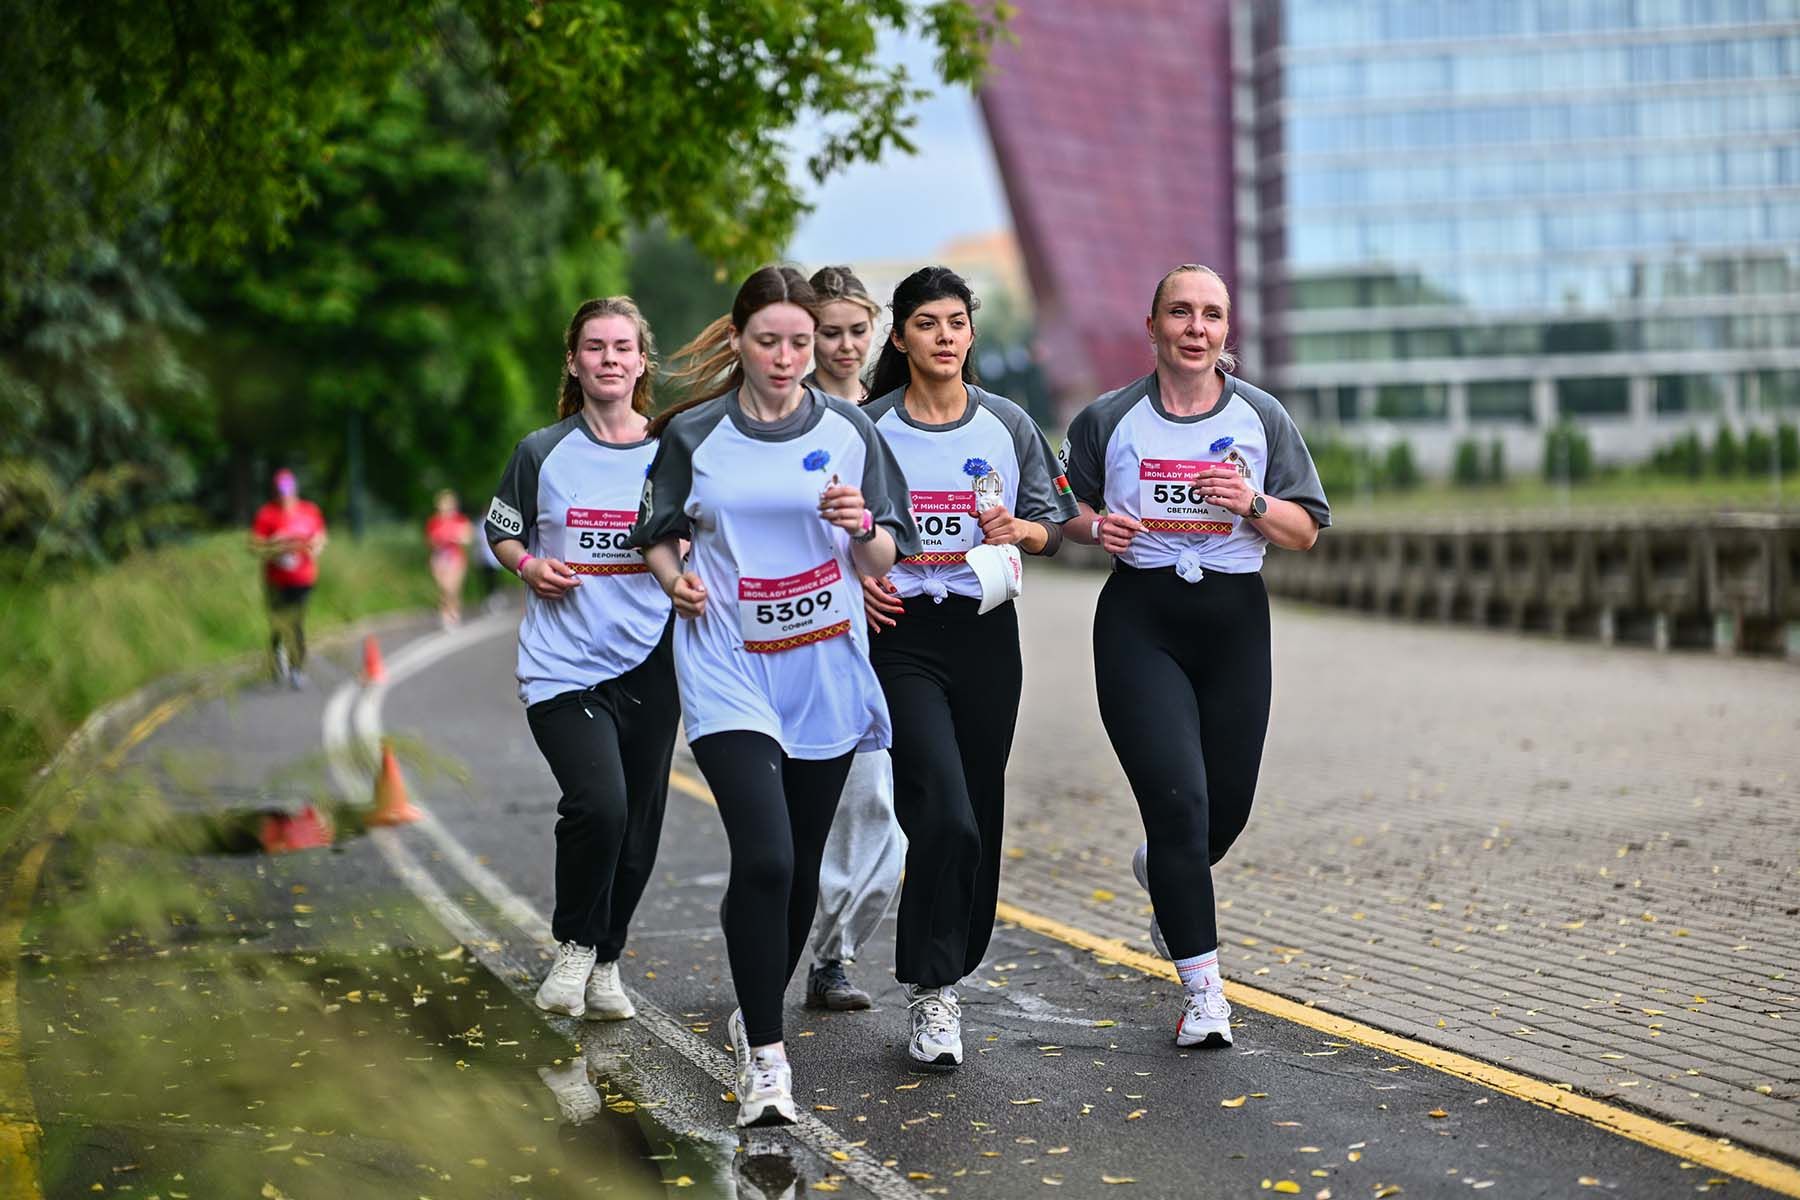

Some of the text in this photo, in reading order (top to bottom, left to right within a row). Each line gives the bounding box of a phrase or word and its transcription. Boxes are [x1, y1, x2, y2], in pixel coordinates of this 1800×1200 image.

[1153, 484, 1205, 505] 530
[1167, 506, 1209, 515] СВЕТЛАНА
[490, 509, 520, 532] 5308
[571, 519, 609, 527] IRONLADY
[915, 516, 961, 536] 05
[579, 531, 629, 550] 530
[921, 538, 942, 546] ЛЕНА
[743, 589, 787, 599] IRONLADY
[788, 581, 819, 595] МИНСК
[756, 590, 832, 625] 5309
[782, 619, 813, 632] СОФИЯ
